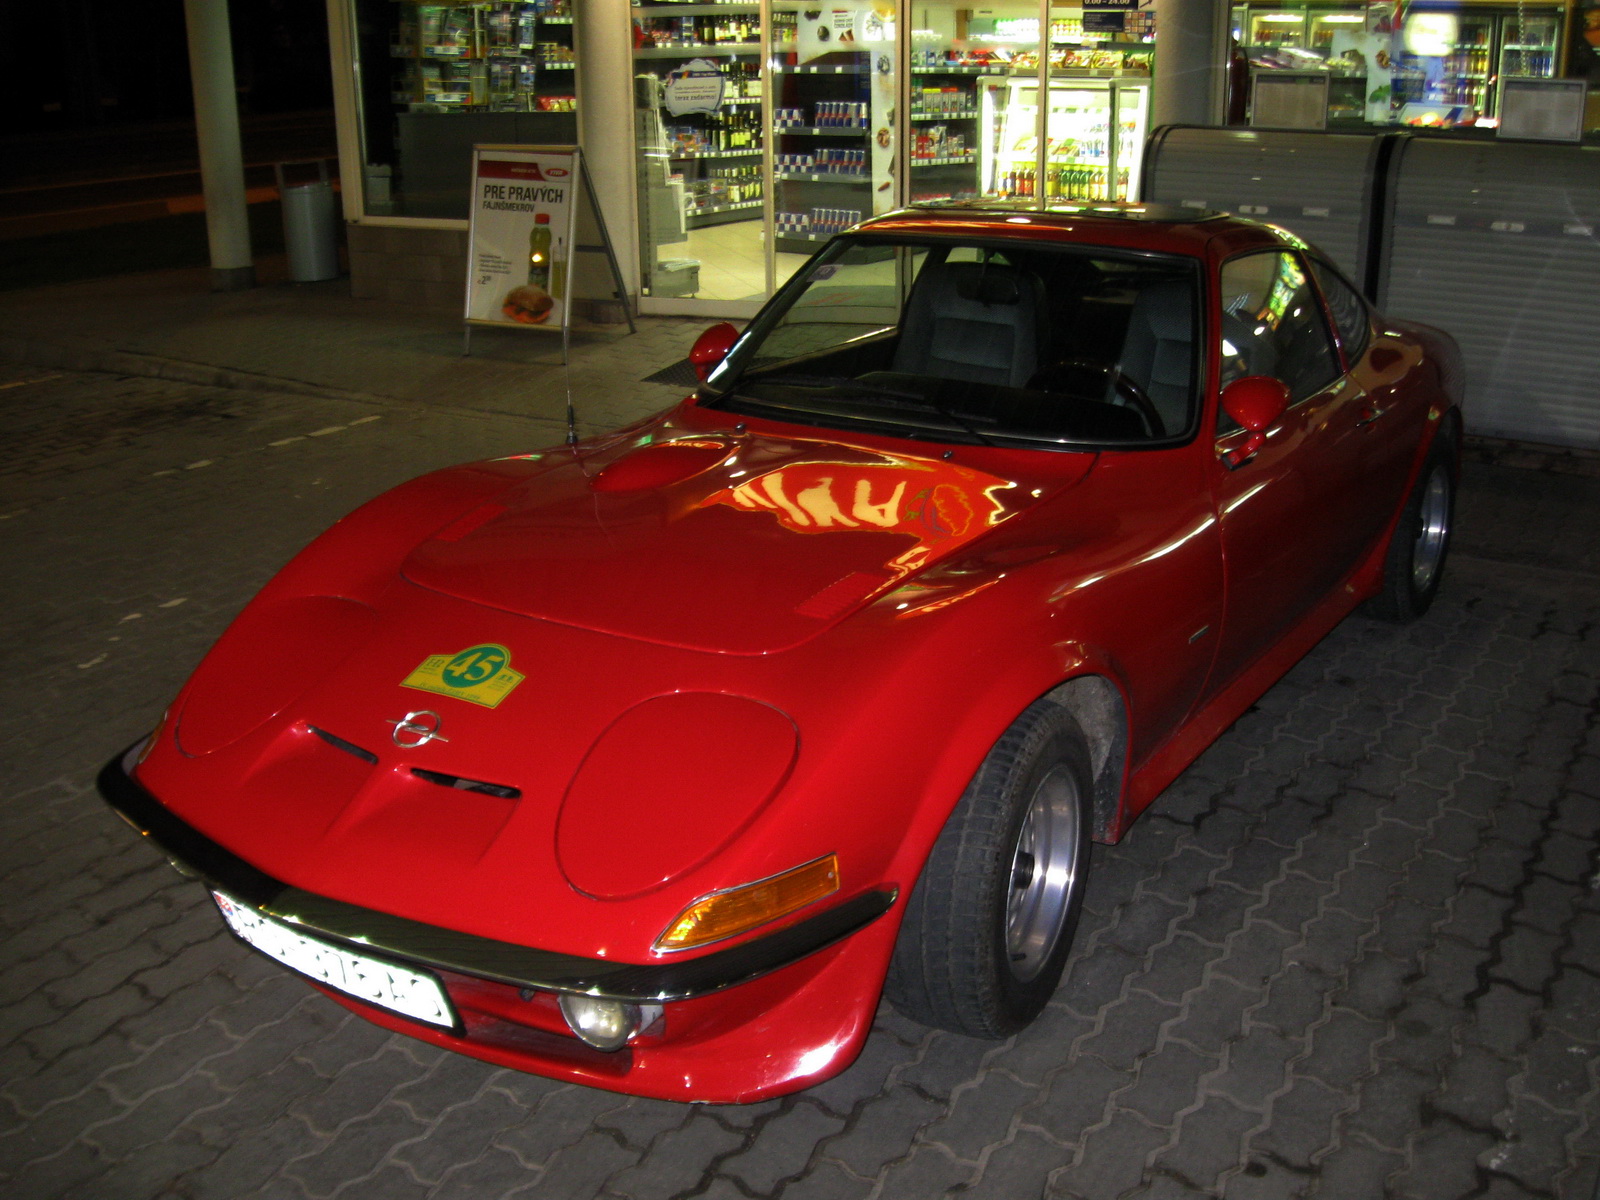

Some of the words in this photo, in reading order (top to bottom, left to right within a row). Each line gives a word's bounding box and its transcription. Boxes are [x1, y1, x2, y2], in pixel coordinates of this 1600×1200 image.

[483, 185, 505, 199] PRE
[508, 184, 564, 203] PRAVÝCH
[483, 201, 535, 212] FAJNŠMEKROV
[446, 652, 504, 681] 45
